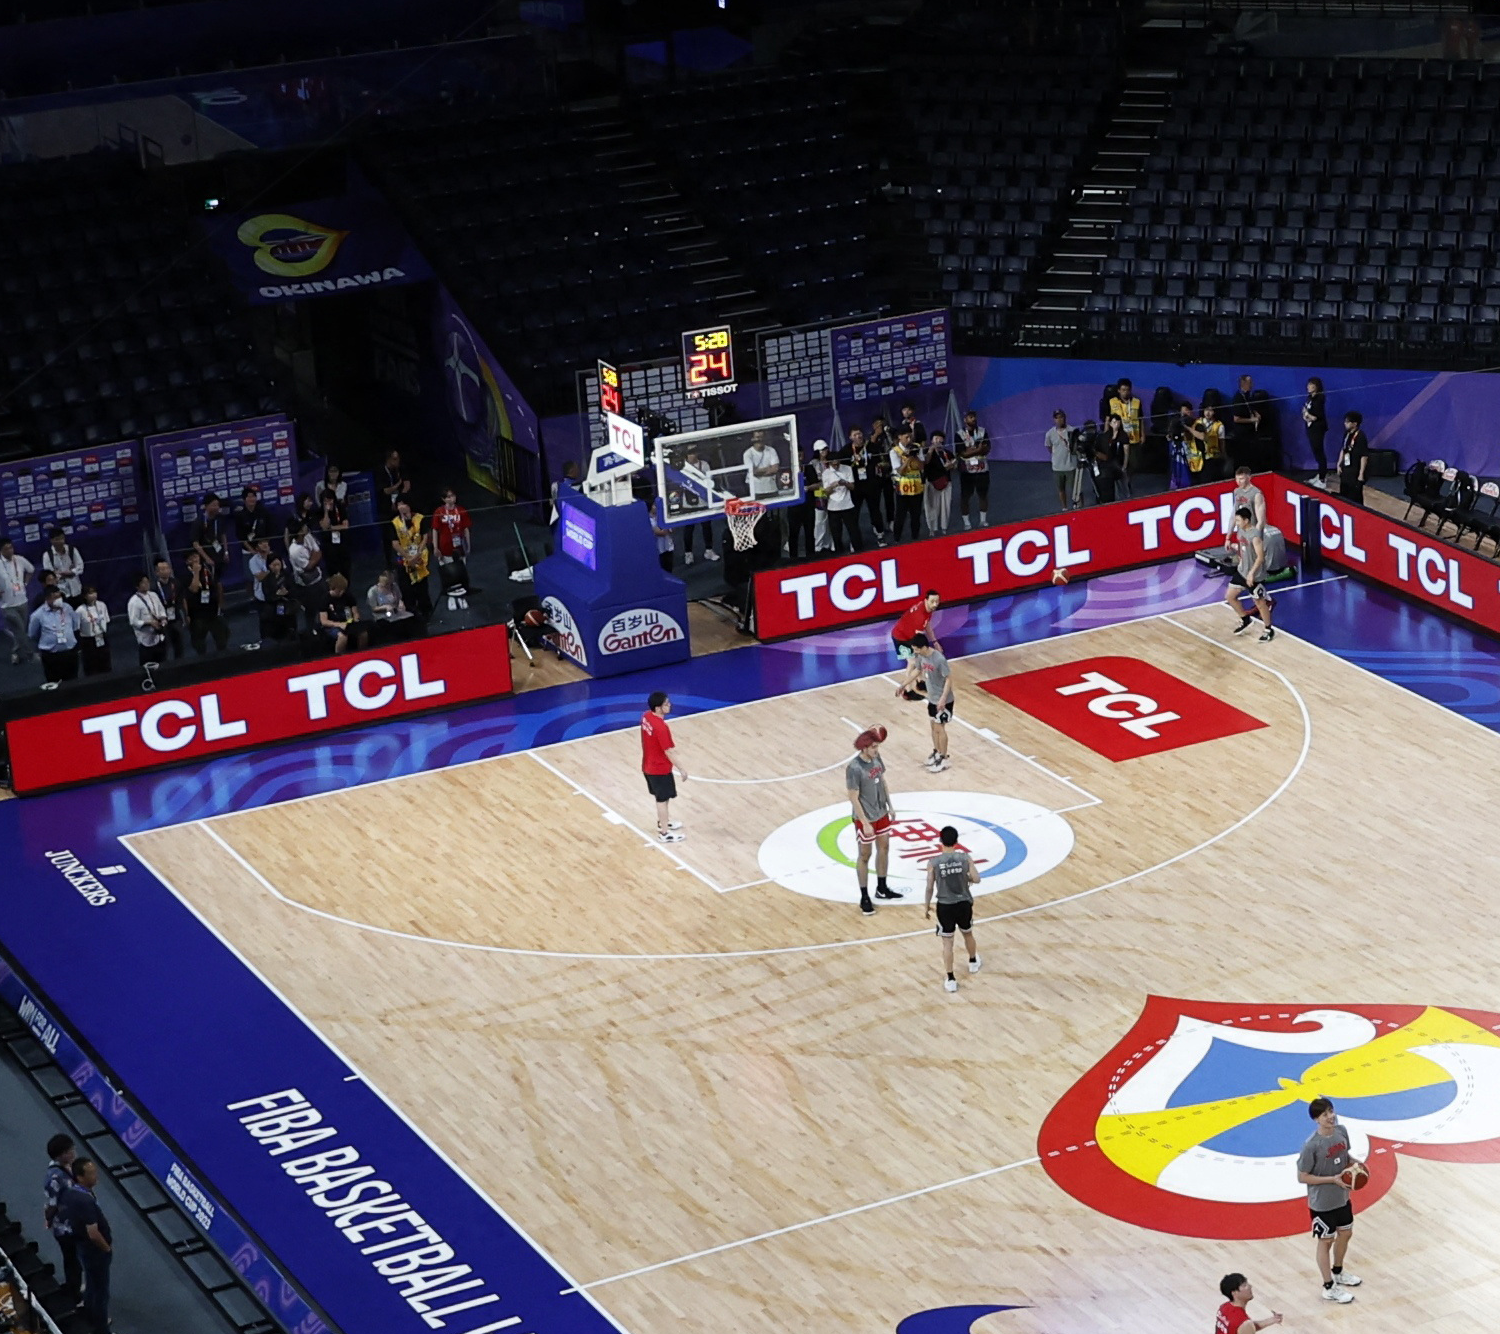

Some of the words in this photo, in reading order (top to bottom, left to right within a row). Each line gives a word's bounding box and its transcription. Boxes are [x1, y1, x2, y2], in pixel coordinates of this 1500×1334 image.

[258, 265, 405, 297] OKINAWA
[689, 351, 728, 385] 24
[694, 330, 728, 352] 5:28
[699, 383, 738, 399] TISSOT
[612, 422, 642, 457] TCL
[781, 559, 918, 619] TCL
[958, 525, 1090, 584] TCL
[1389, 533, 1474, 609] TCL
[82, 694, 246, 761] TCL
[288, 654, 444, 719] TCL
[1052, 670, 1183, 741] TCL
[44, 848, 116, 907] JUNCKERS
[225, 1085, 320, 1166] FIBA
[282, 1142, 488, 1331] BASKETBALL
